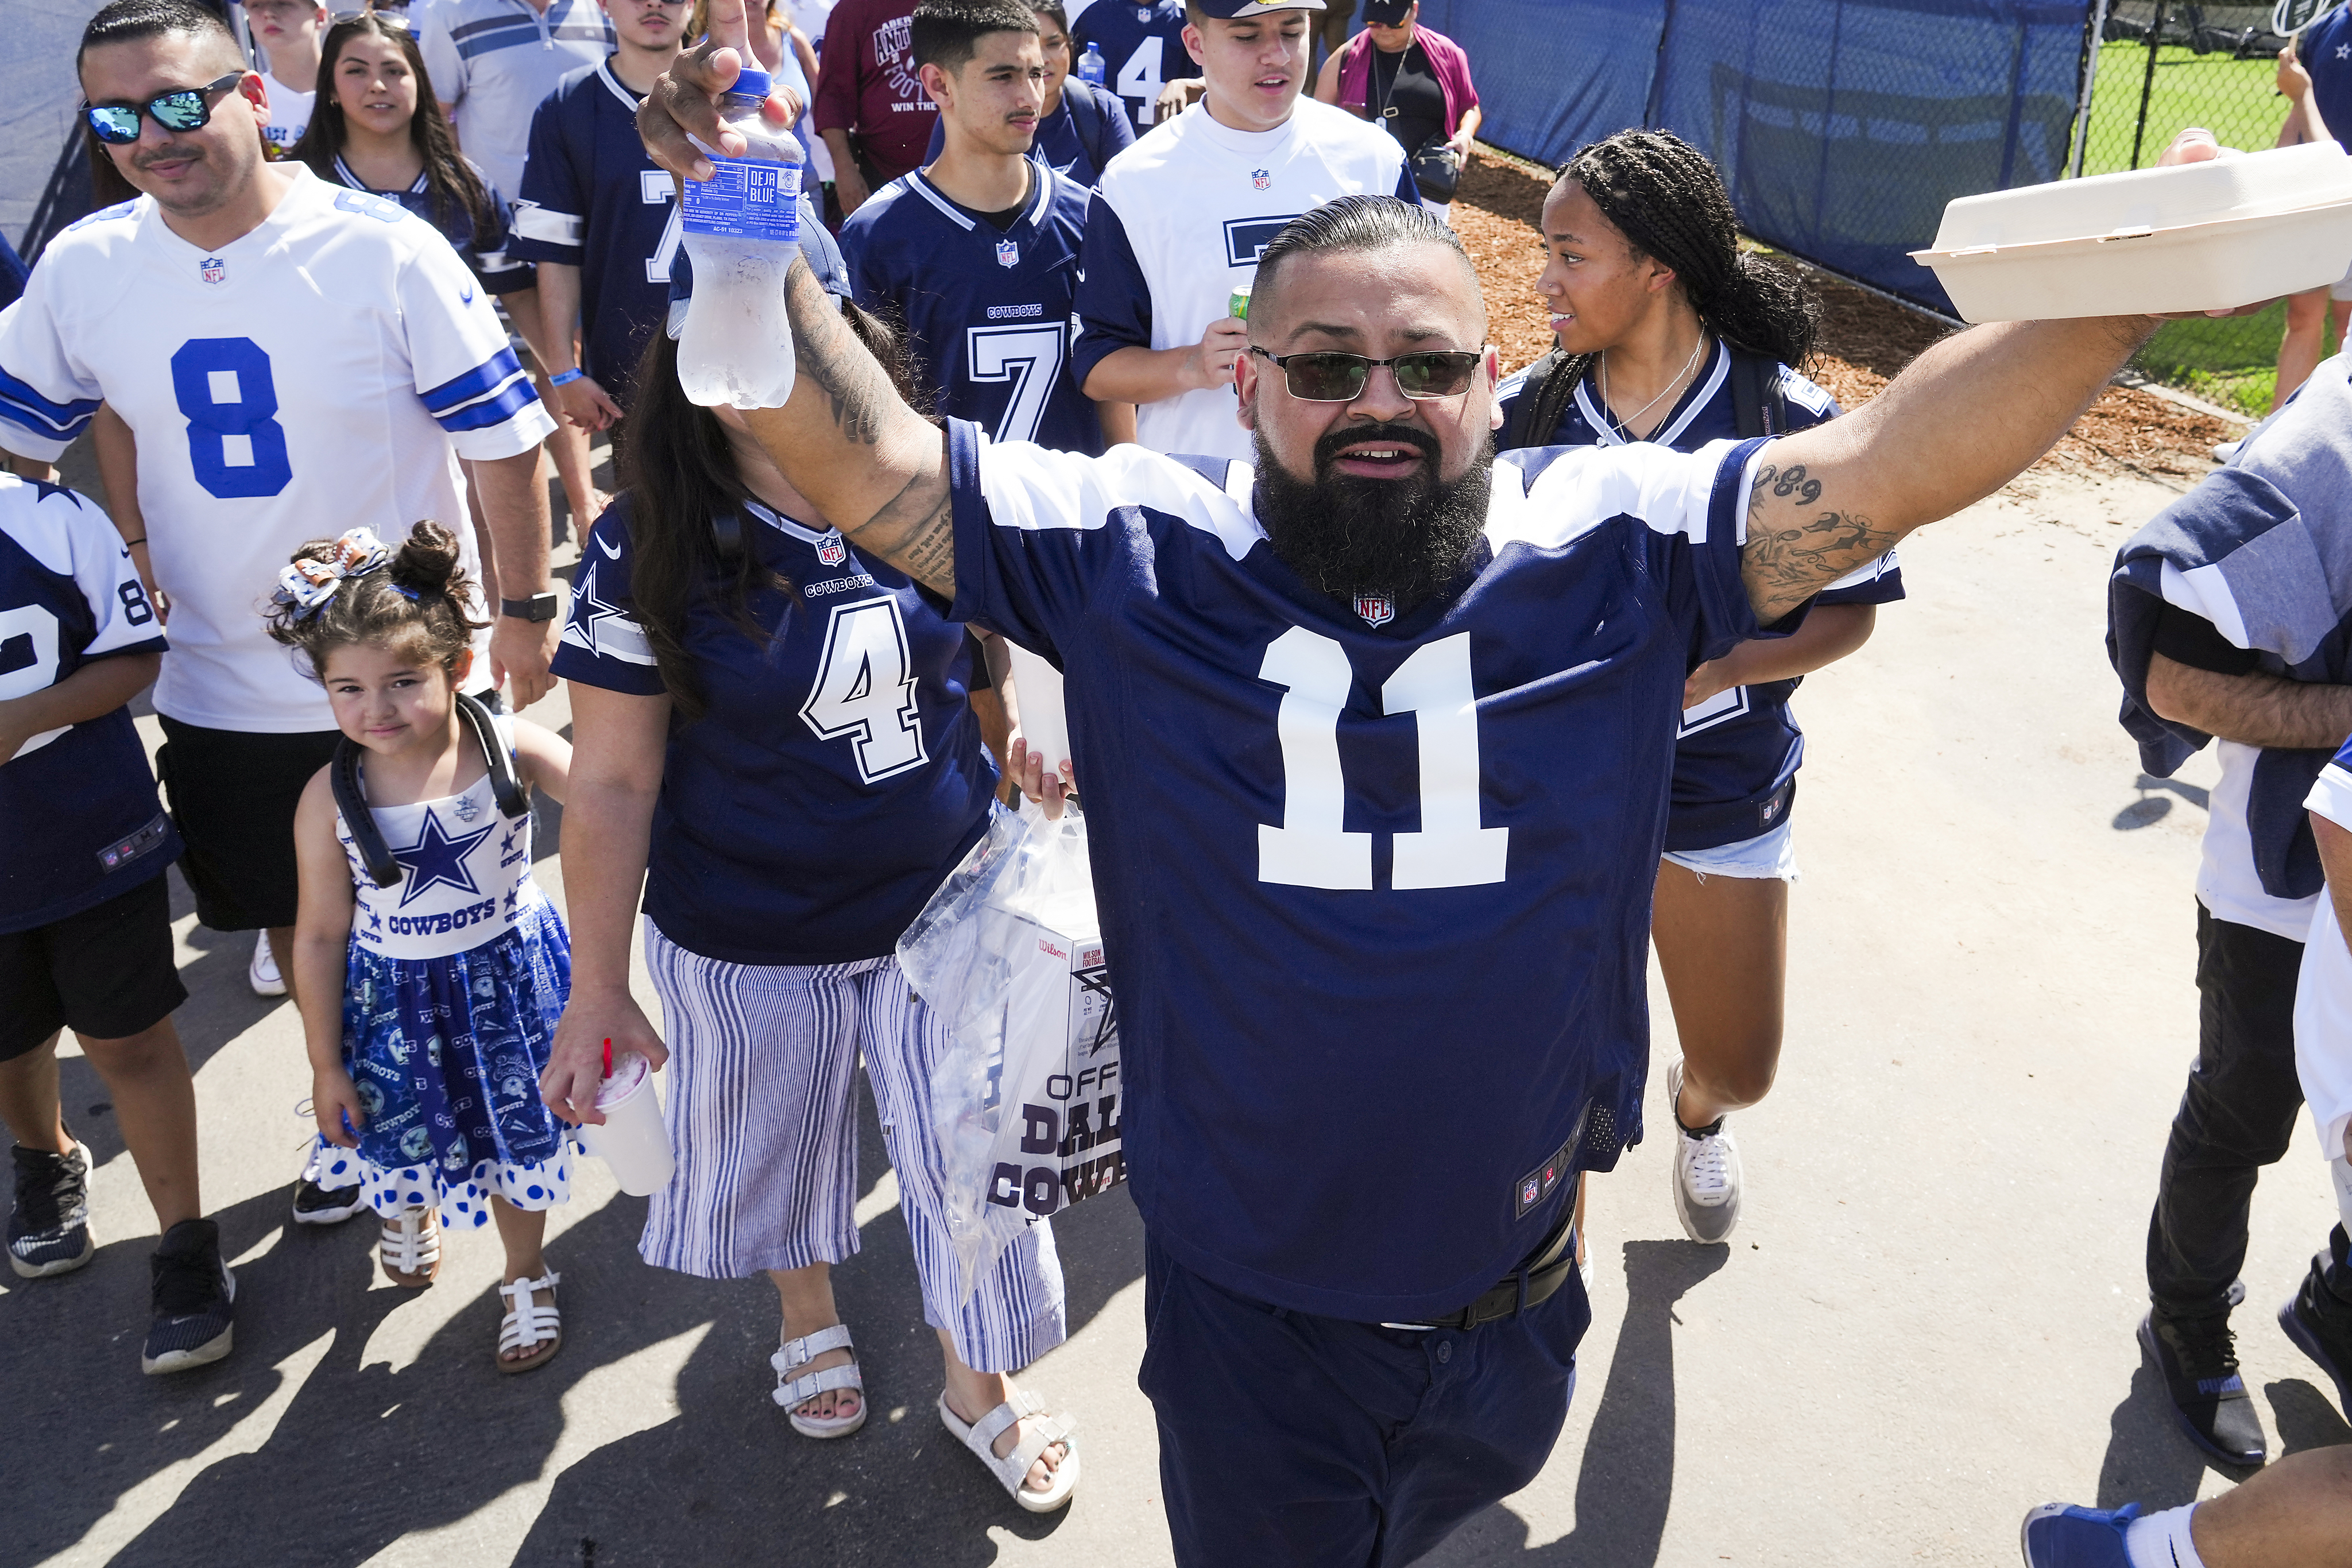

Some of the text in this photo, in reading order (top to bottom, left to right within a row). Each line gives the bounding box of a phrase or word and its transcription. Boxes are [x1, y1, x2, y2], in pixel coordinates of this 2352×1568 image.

[1117, 36, 1166, 125] 4
[891, 102, 937, 112] WIN THE
[751, 171, 775, 187] DEJA
[1254, 177, 1270, 188] NFL
[750, 187, 775, 203] BLUE
[334, 190, 408, 223] 8
[640, 170, 683, 283] 7
[1001, 250, 1016, 262] NFL
[205, 268, 225, 281] NFL
[987, 304, 1042, 320] COWBOYS
[967, 322, 1065, 444] 7
[171, 337, 292, 498] 8
[820, 548, 844, 562] NFL
[805, 574, 875, 598] COWBOYS
[118, 579, 153, 626] 8
[1358, 598, 1390, 620] NFL
[798, 595, 930, 785] 4
[1258, 625, 1510, 890] 11
[389, 897, 495, 936] COWBOYS
[1039, 939, 1067, 961] Wilson
[1083, 948, 1101, 961] WILSON
[1082, 955, 1106, 969] FOOTBALL
[1047, 1062, 1119, 1101] OFF
[1020, 1094, 1121, 1157] DAL
[1525, 1188, 1536, 1201] NFL
[2198, 1375, 2242, 1395] PUMA
